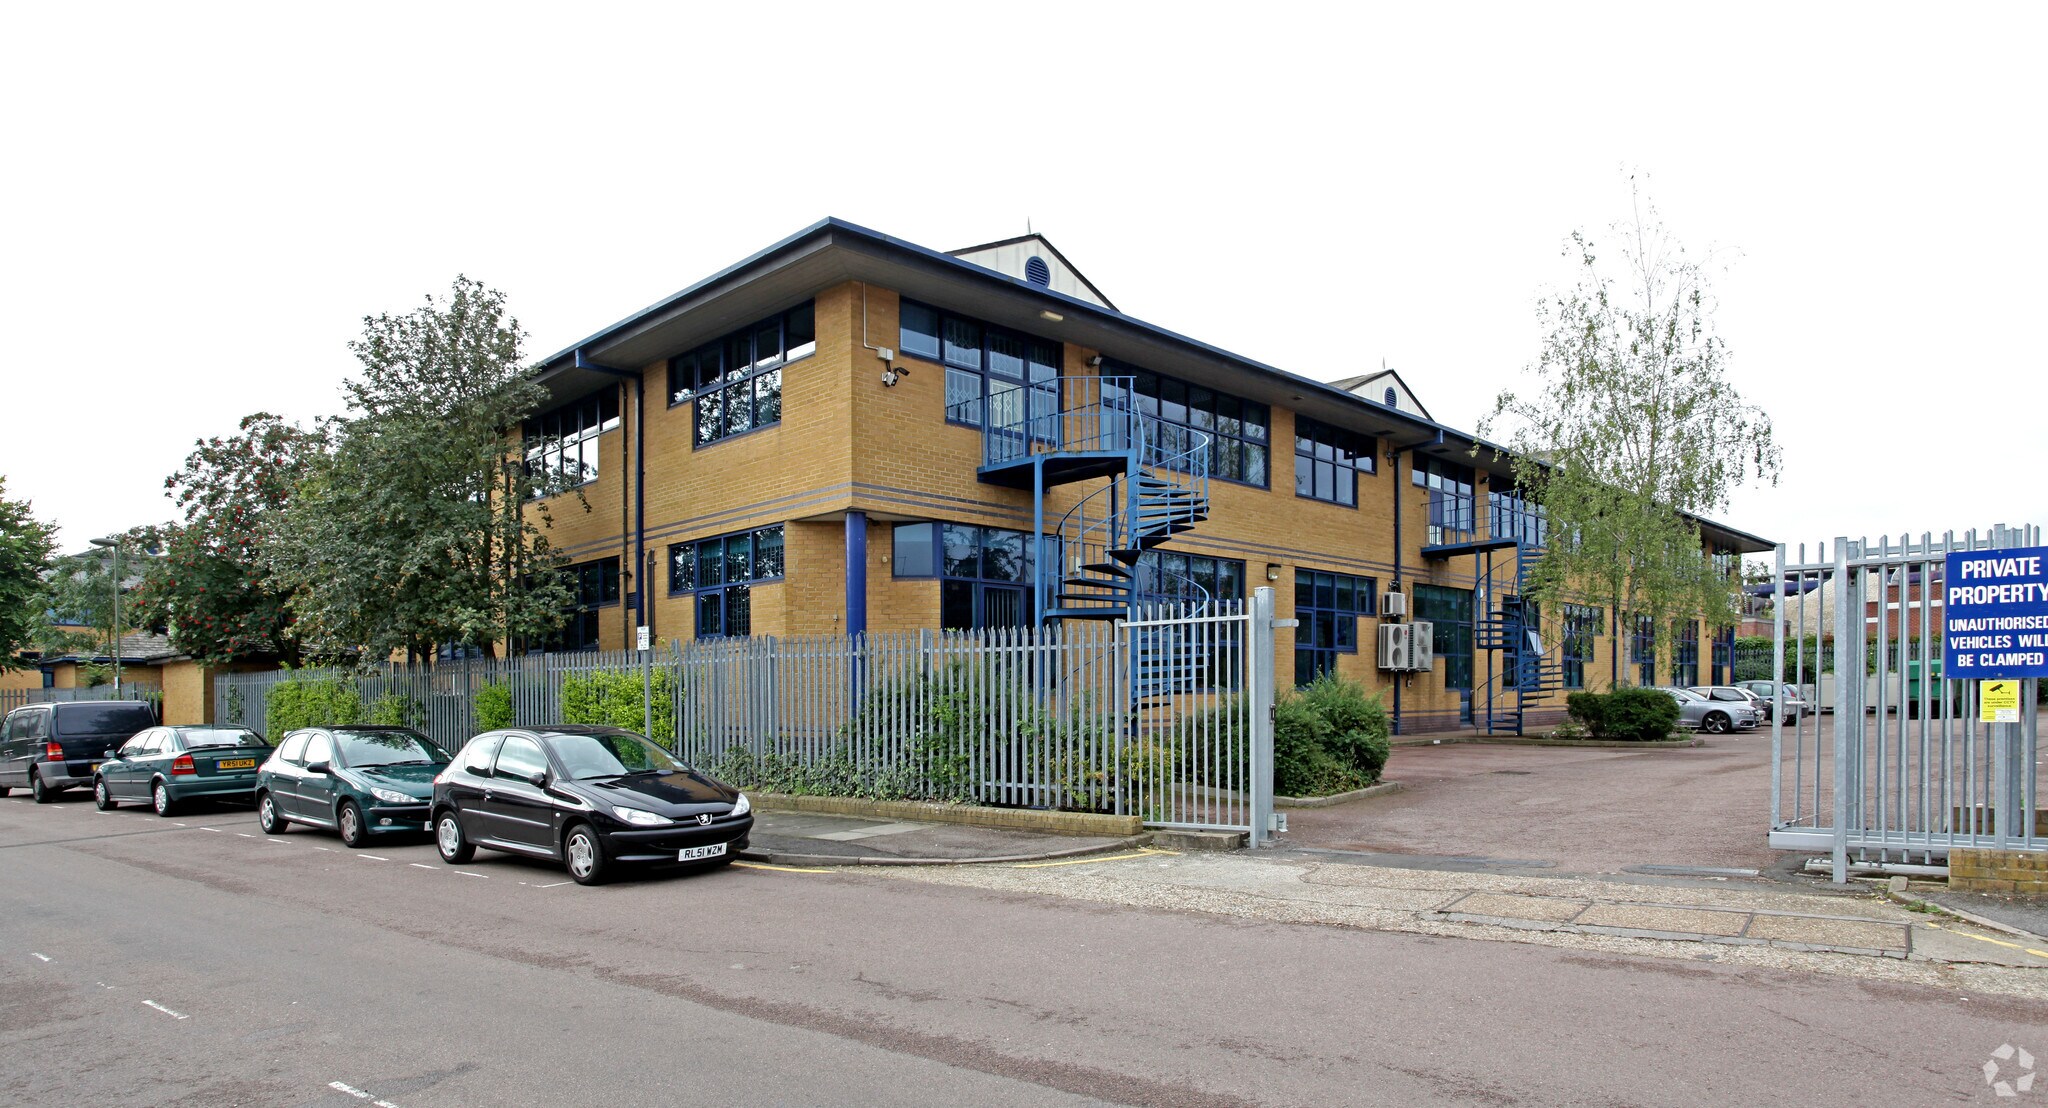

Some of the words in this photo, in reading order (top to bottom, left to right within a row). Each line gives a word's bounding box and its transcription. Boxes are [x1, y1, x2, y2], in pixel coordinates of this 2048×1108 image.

[1961, 556, 2041, 579] PRIVATE
[1949, 582, 2048, 606] PROPERTY
[1950, 634, 2012, 650] VEHICLES
[1957, 653, 1974, 667] BE
[1980, 652, 2044, 667] CLAMPED
